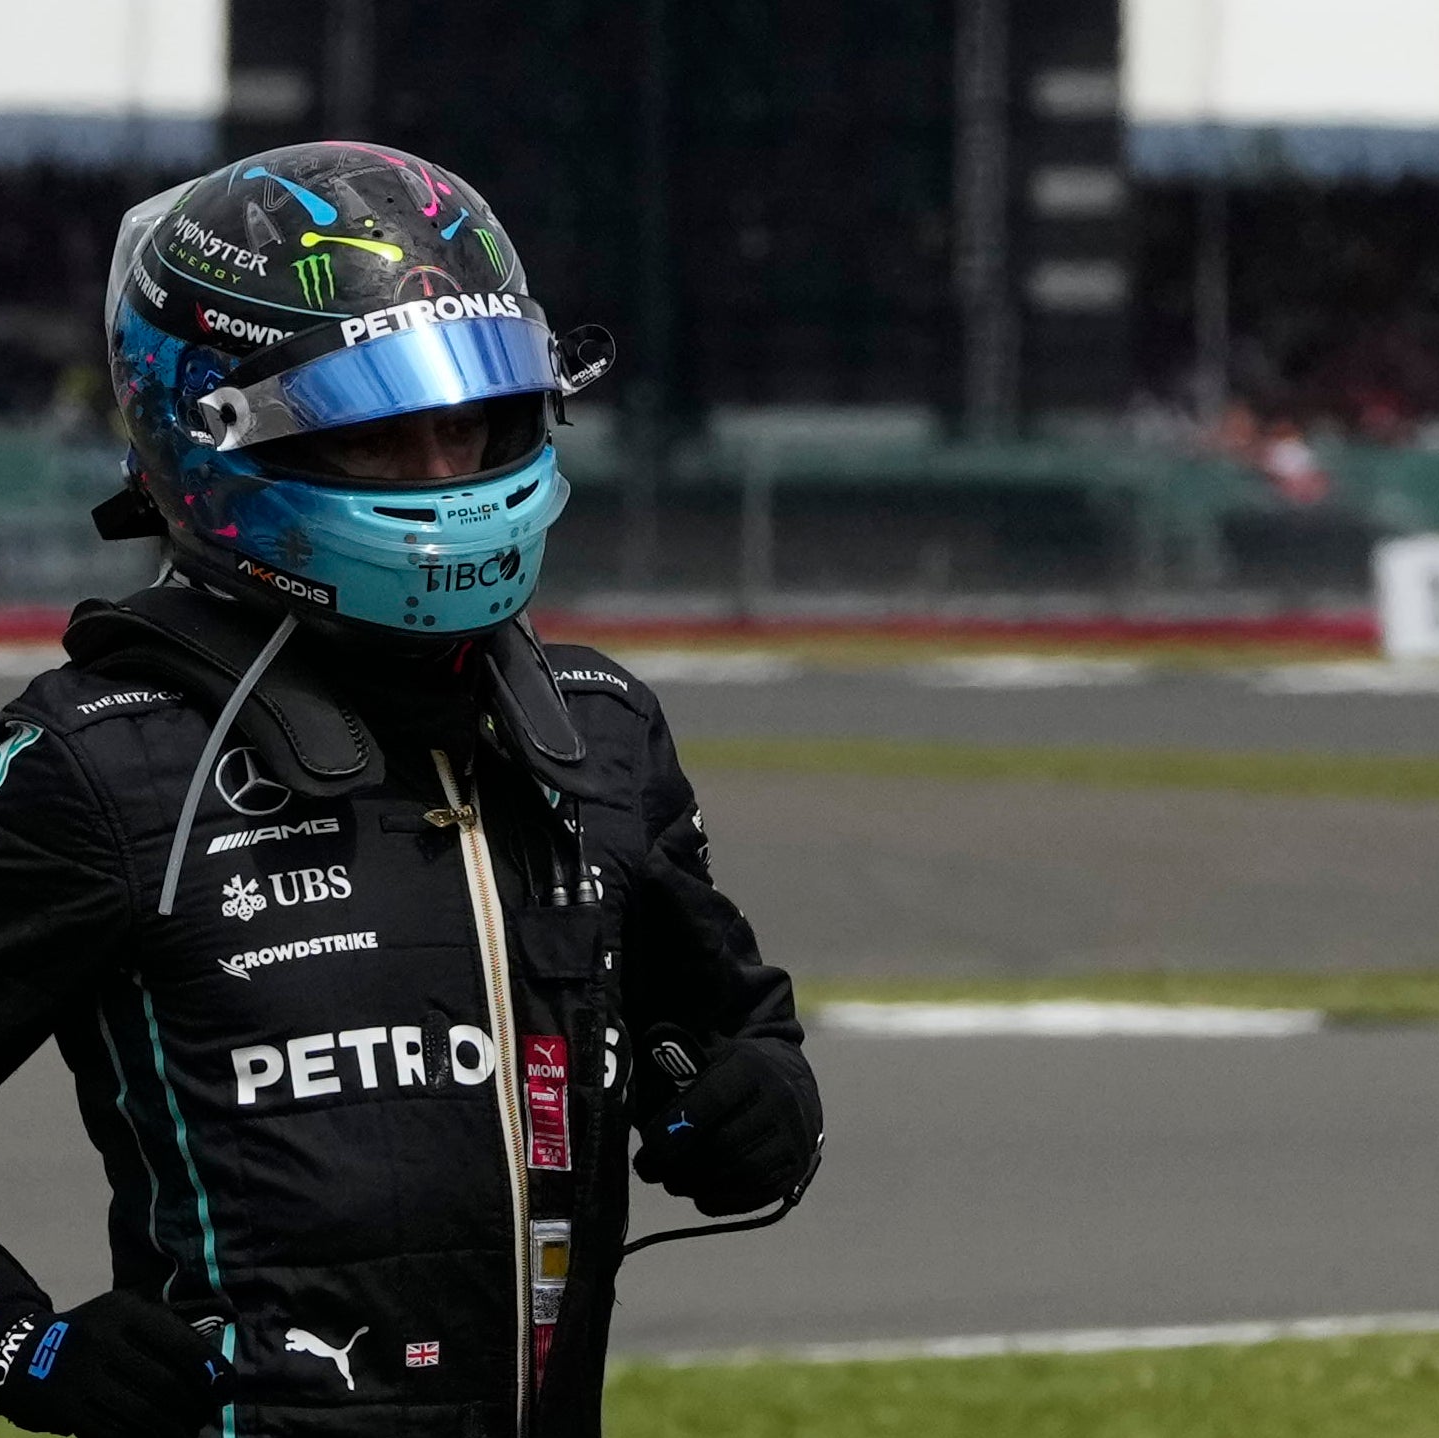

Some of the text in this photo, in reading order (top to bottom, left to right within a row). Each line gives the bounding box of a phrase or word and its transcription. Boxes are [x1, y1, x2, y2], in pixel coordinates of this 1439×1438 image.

[168, 242, 242, 285] ENERGY
[340, 292, 523, 348] PETRONAS
[571, 357, 608, 382] POLICE
[447, 502, 500, 519] POLICE
[76, 696, 114, 715] THE
[251, 817, 340, 845] AMG
[268, 864, 352, 906] UBS
[230, 931, 379, 971] CROWDSTRIKE
